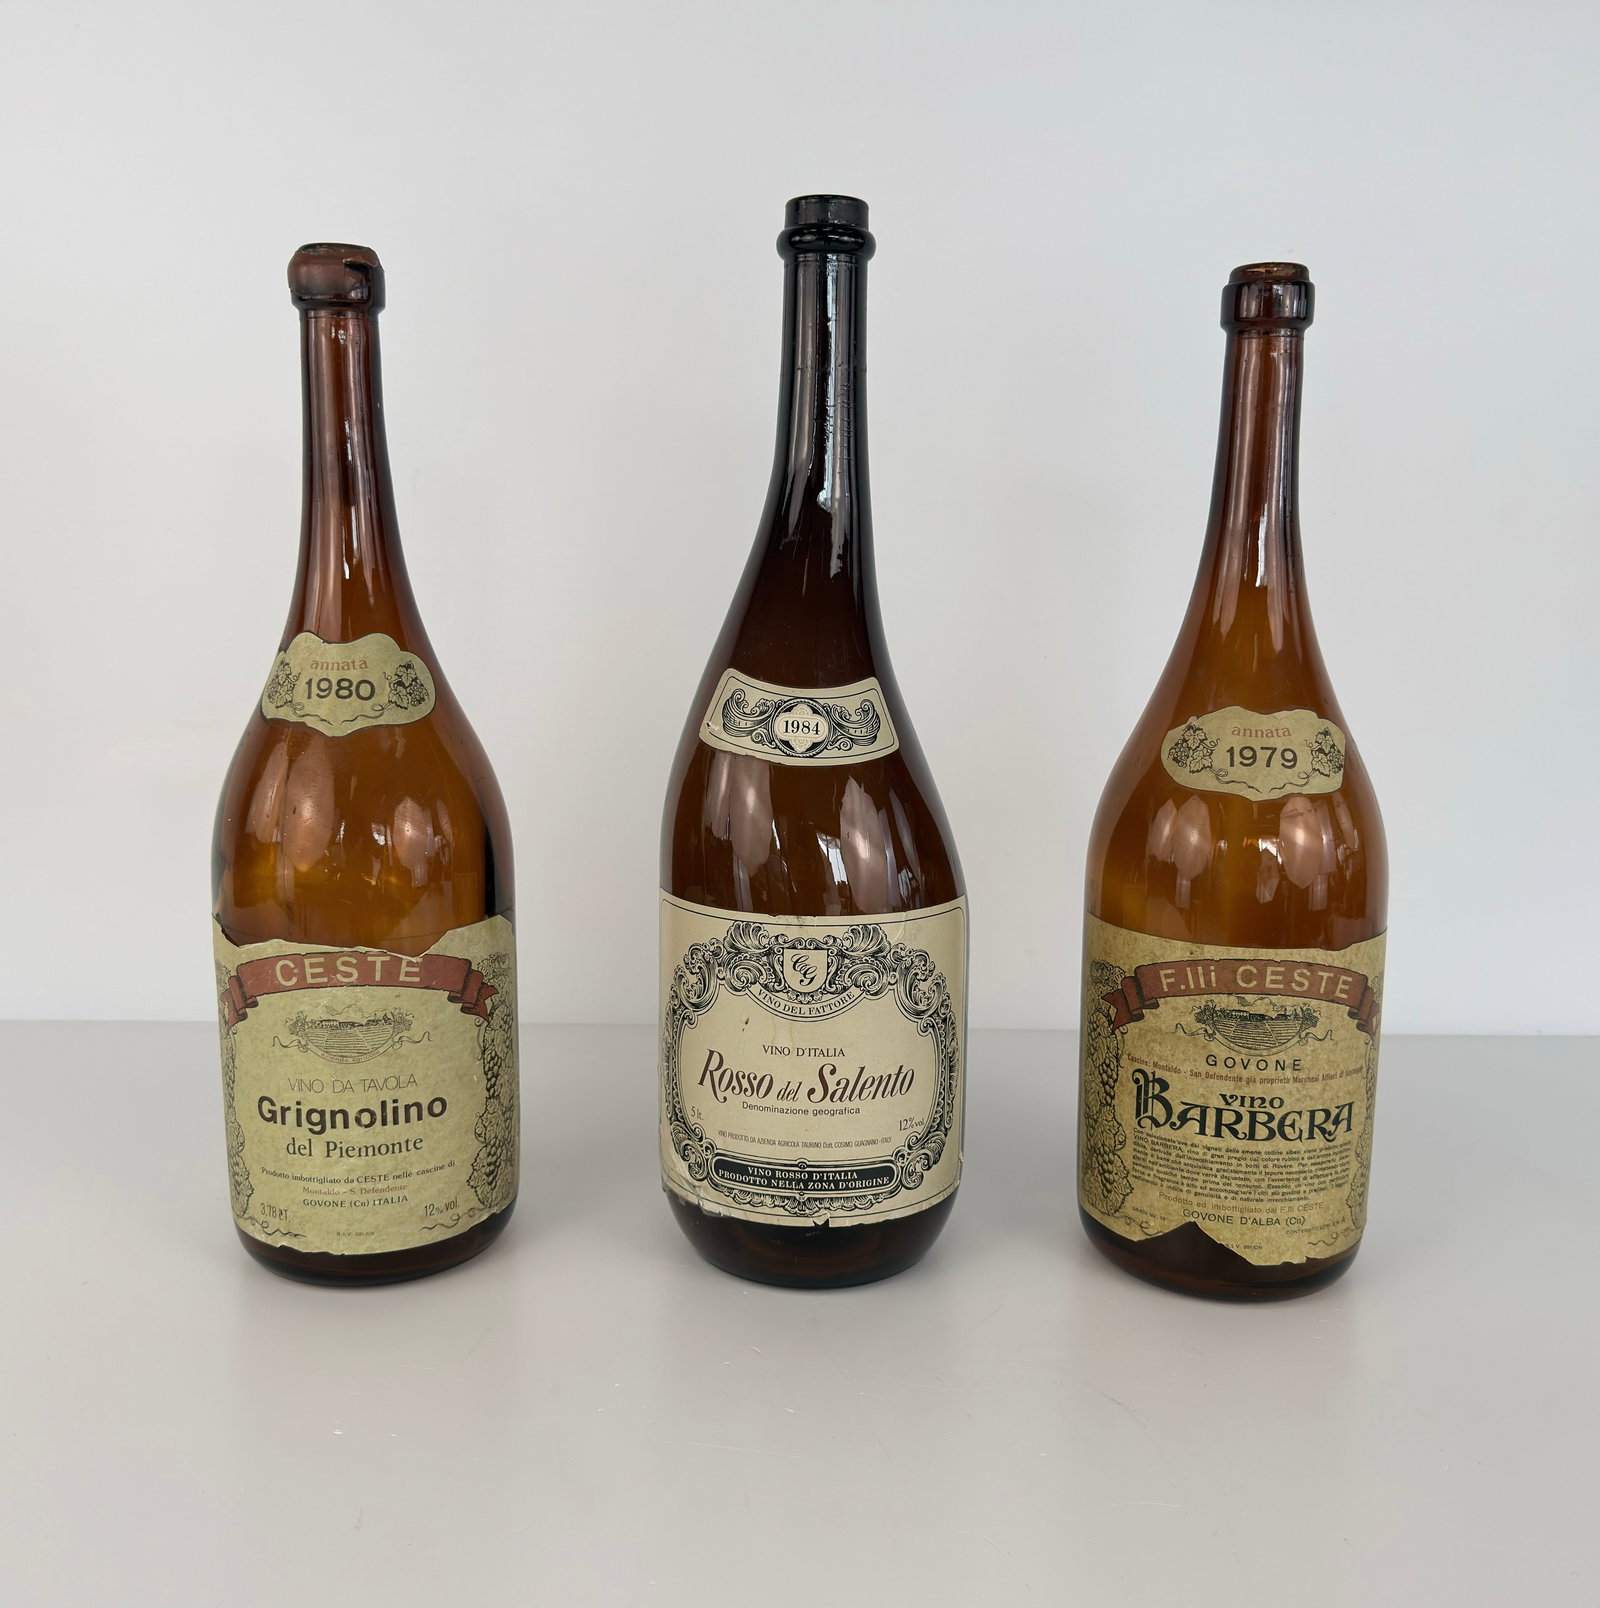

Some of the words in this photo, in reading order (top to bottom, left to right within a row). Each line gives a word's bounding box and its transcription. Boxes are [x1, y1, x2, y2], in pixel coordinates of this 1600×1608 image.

[310, 658, 369, 671] annata
[305, 678, 376, 701] 1980
[782, 719, 821, 735] 1984
[1231, 725, 1292, 738] annata
[1226, 745, 1298, 770] 1979
[275, 956, 422, 987] CESTE
[1235, 965, 1354, 999] CESTE
[758, 988, 781, 1008] VINO
[782, 1004, 806, 1015] DEL
[808, 993, 855, 1015] FATTORE
[762, 1044, 791, 1056] VINO
[796, 1047, 846, 1057] D'ITALIA
[1152, 1061, 1181, 1074] Montaldo
[1189, 1069, 1202, 1078] San
[1205, 1071, 1243, 1083] Defendente
[1205, 1054, 1302, 1071] GOVONE
[287, 1077, 324, 1094] VINO
[332, 1079, 354, 1094] DA
[360, 1073, 418, 1093] TAVOLA
[697, 1049, 775, 1104] Rosso
[776, 1080, 802, 1102] del
[806, 1062, 915, 1104] Salento
[257, 1095, 448, 1135] Grignolino
[691, 1106, 696, 1117] 5
[742, 1101, 809, 1116] Denominazione
[812, 1106, 861, 1117] geografica
[1131, 1068, 1355, 1143] BARBERA
[899, 1116, 914, 1131] 12%
[286, 1137, 312, 1157] del
[325, 1137, 424, 1158] Piemonte
[718, 1130, 727, 1138] VINO
[728, 1131, 749, 1142] PRODOTTO
[757, 1138, 777, 1146] AZIENDA
[777, 1140, 800, 1148] AGRICOLA
[1133, 1133, 1149, 1143] VINO
[261, 1167, 289, 1179] Prodotto
[292, 1173, 341, 1184] imbottigliato
[356, 1174, 390, 1184] CESTE
[392, 1171, 413, 1180] nelle
[416, 1163, 445, 1176] cascine
[448, 1159, 456, 1168] di
[718, 1169, 768, 1186] PRODOTTO
[771, 1179, 805, 1190] NELLA
[807, 1181, 836, 1190] ZONA
[839, 1176, 890, 1189] D'ORIGINE
[747, 1166, 772, 1177] VINO
[775, 1170, 809, 1180] ROSSO
[812, 1171, 858, 1180] D'ITALIA
[303, 1186, 340, 1195] Montaldo
[360, 1184, 408, 1195] Defendente
[302, 1198, 346, 1208] GOVONE
[349, 1199, 370, 1208] (Cn)
[373, 1195, 408, 1207] ITALIA
[1159, 1191, 1193, 1206] Prodotto
[1196, 1201, 1207, 1209] ed
[1211, 1202, 1262, 1214] imbottigliato
[1265, 1206, 1277, 1214] dai
[1297, 1201, 1324, 1212] CESTE
[1183, 1208, 1234, 1224] GOVONE
[1240, 1216, 1281, 1226] D'ALBA
[1285, 1215, 1305, 1227] (Cn)
